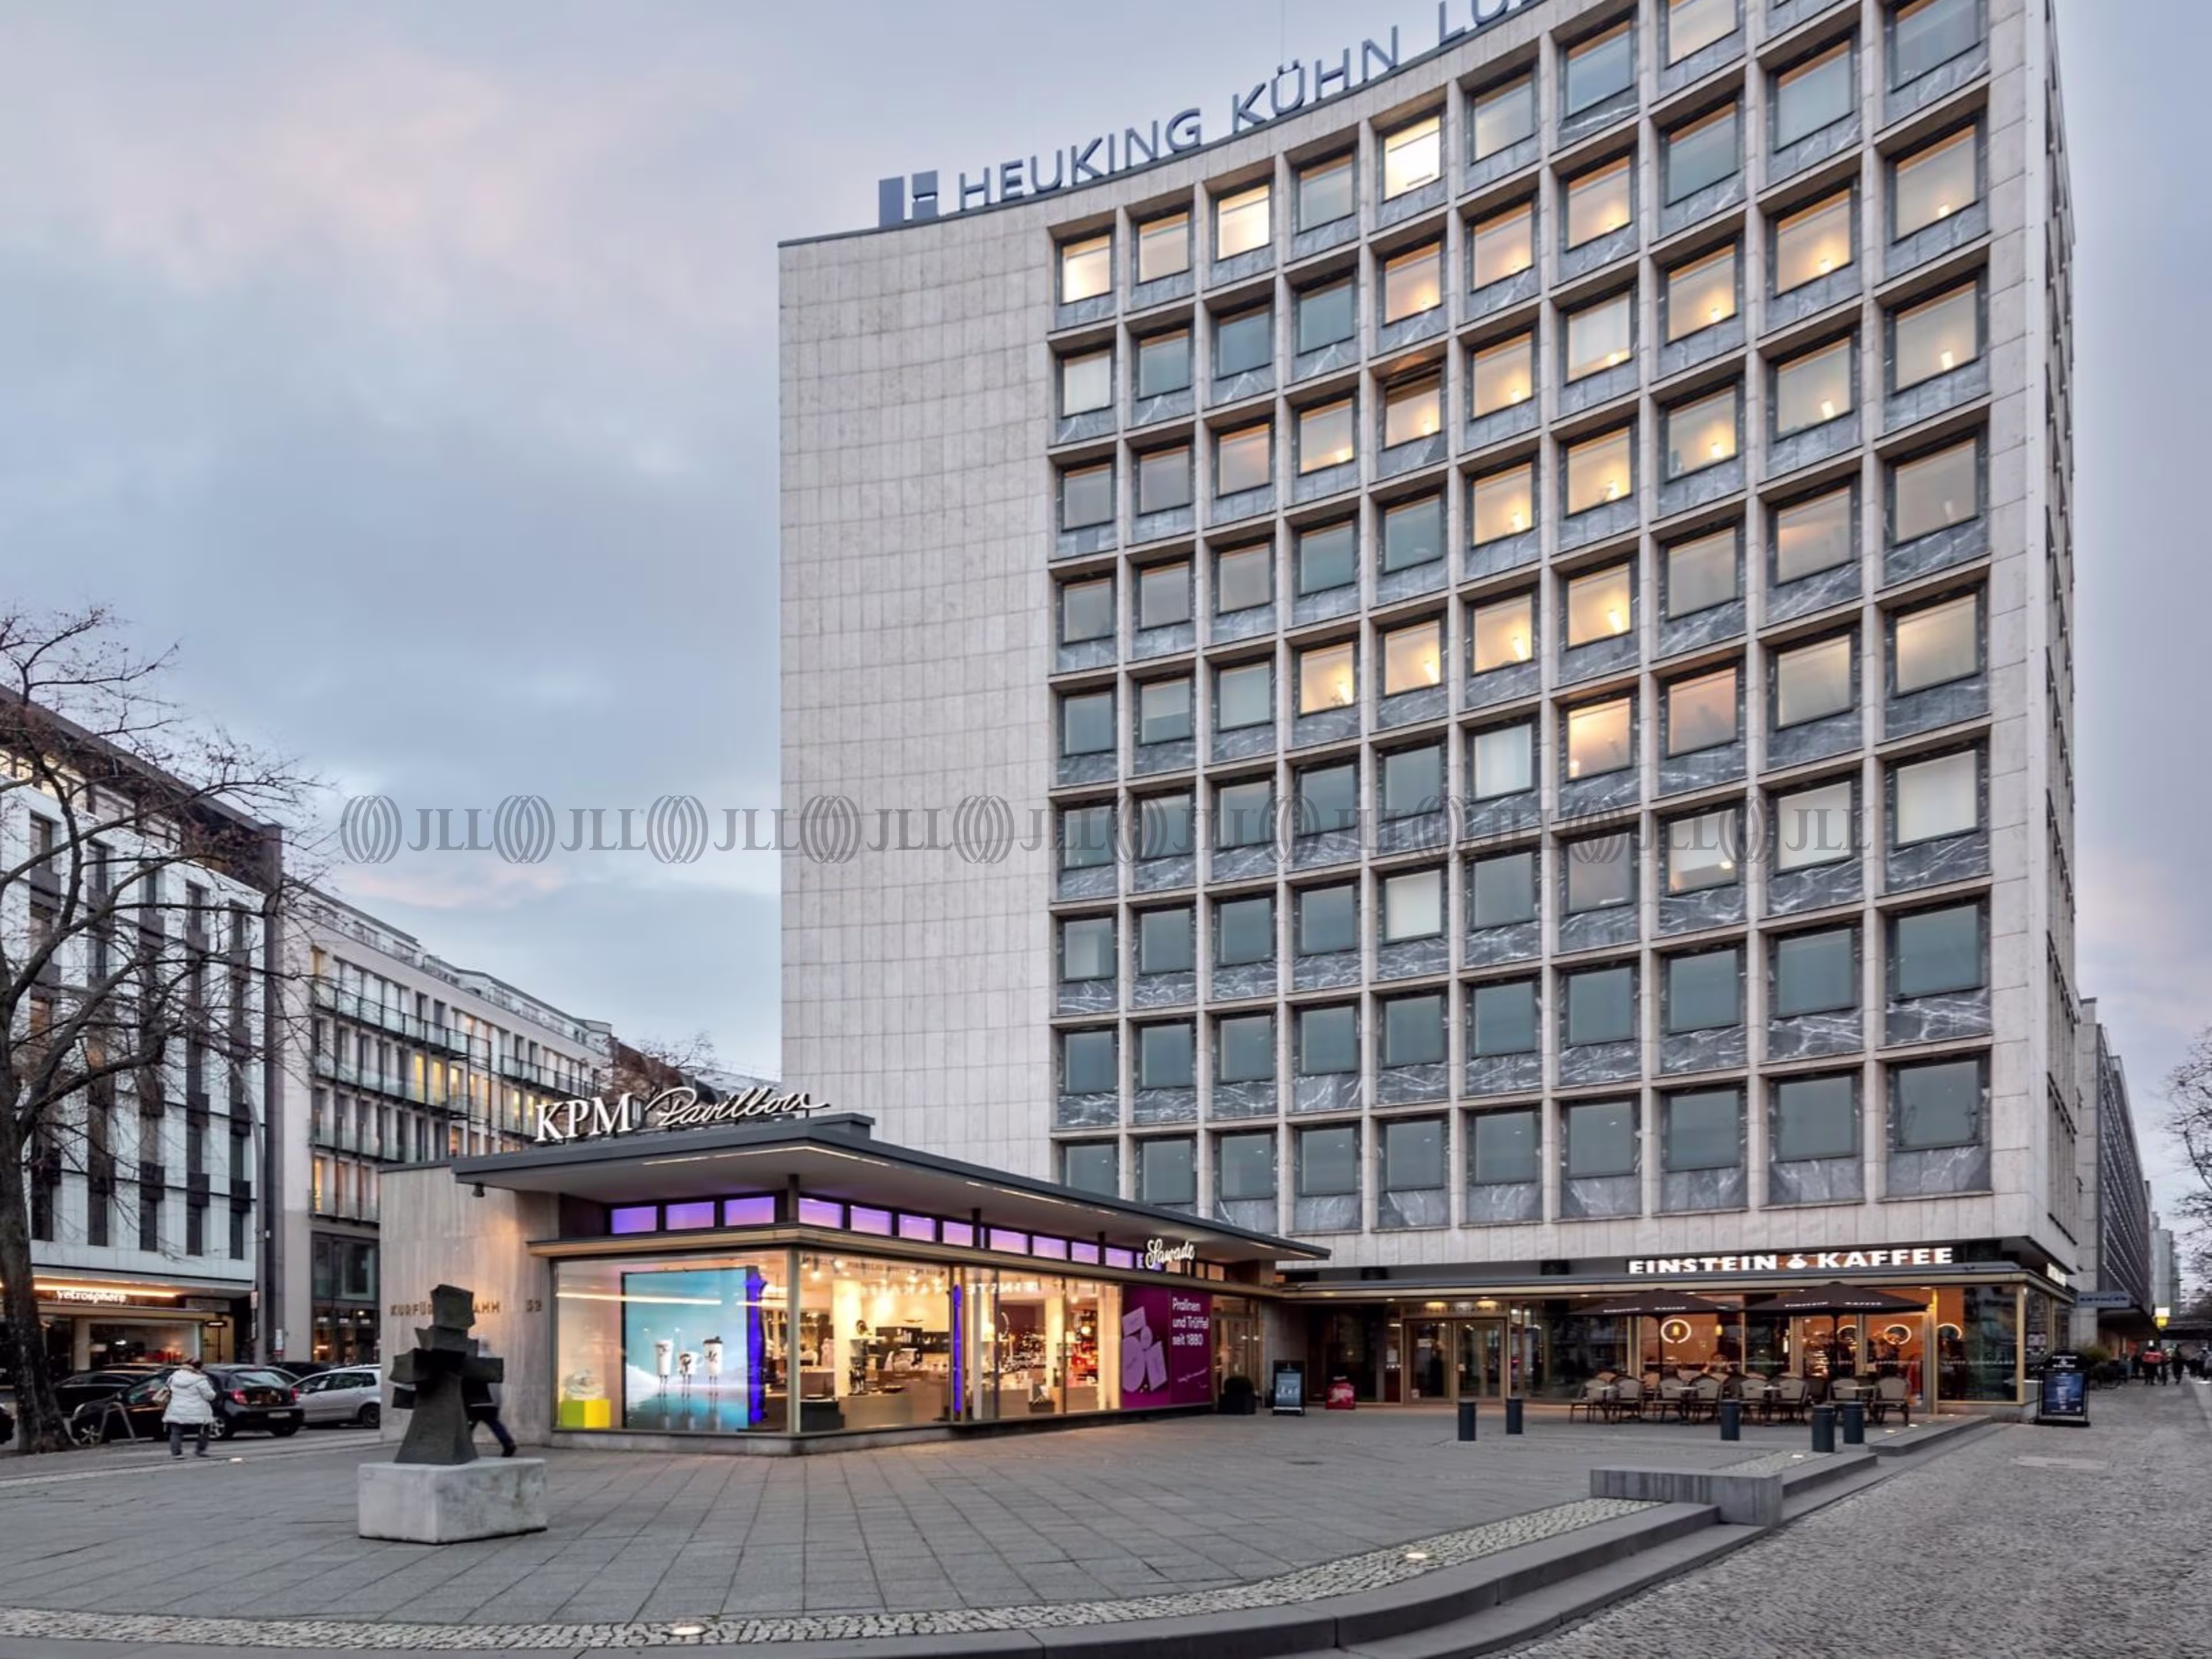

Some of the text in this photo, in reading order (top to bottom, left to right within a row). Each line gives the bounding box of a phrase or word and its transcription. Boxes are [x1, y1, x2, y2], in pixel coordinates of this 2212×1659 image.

[960, 107, 1201, 211] HEUKING
[1233, 25, 1399, 133] KÜHN
[536, 1086, 830, 1142] KPM Pavillon
[1145, 1238, 1195, 1269] Sawade
[1629, 1248, 1952, 1274] EINSTEIN KAFFEE
[1172, 1297, 1200, 1312] Pralinen
[1172, 1316, 1186, 1328] und
[1172, 1334, 1185, 1346] seit
